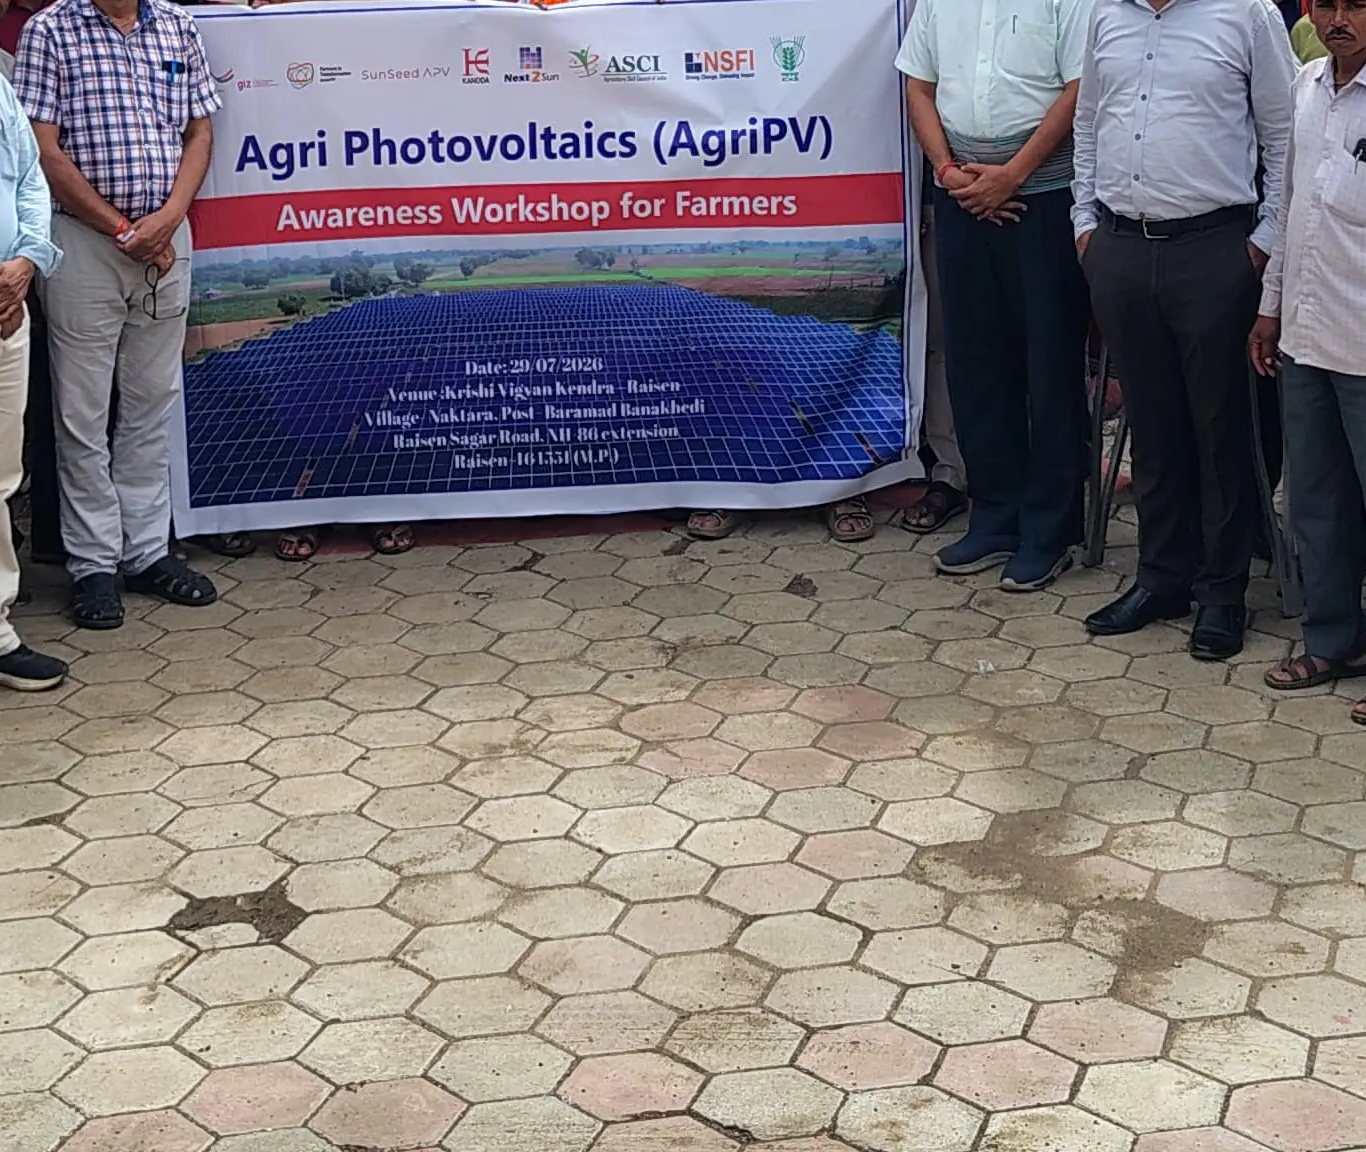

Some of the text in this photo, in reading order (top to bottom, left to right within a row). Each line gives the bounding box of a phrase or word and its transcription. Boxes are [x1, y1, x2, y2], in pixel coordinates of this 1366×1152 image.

[604, 55, 662, 73] ASCI
[704, 49, 754, 73] NSFI
[361, 67, 419, 80] SunSeed
[504, 73, 530, 83] Next
[235, 115, 833, 180] Agri Photovoltaics (AgriPV)
[277, 192, 798, 232] Awareness Workshop for Farmers
[465, 360, 508, 376] Date:
[555, 379, 615, 396] Kendra
[627, 378, 681, 394] Raisen
[600, 423, 680, 441] extension
